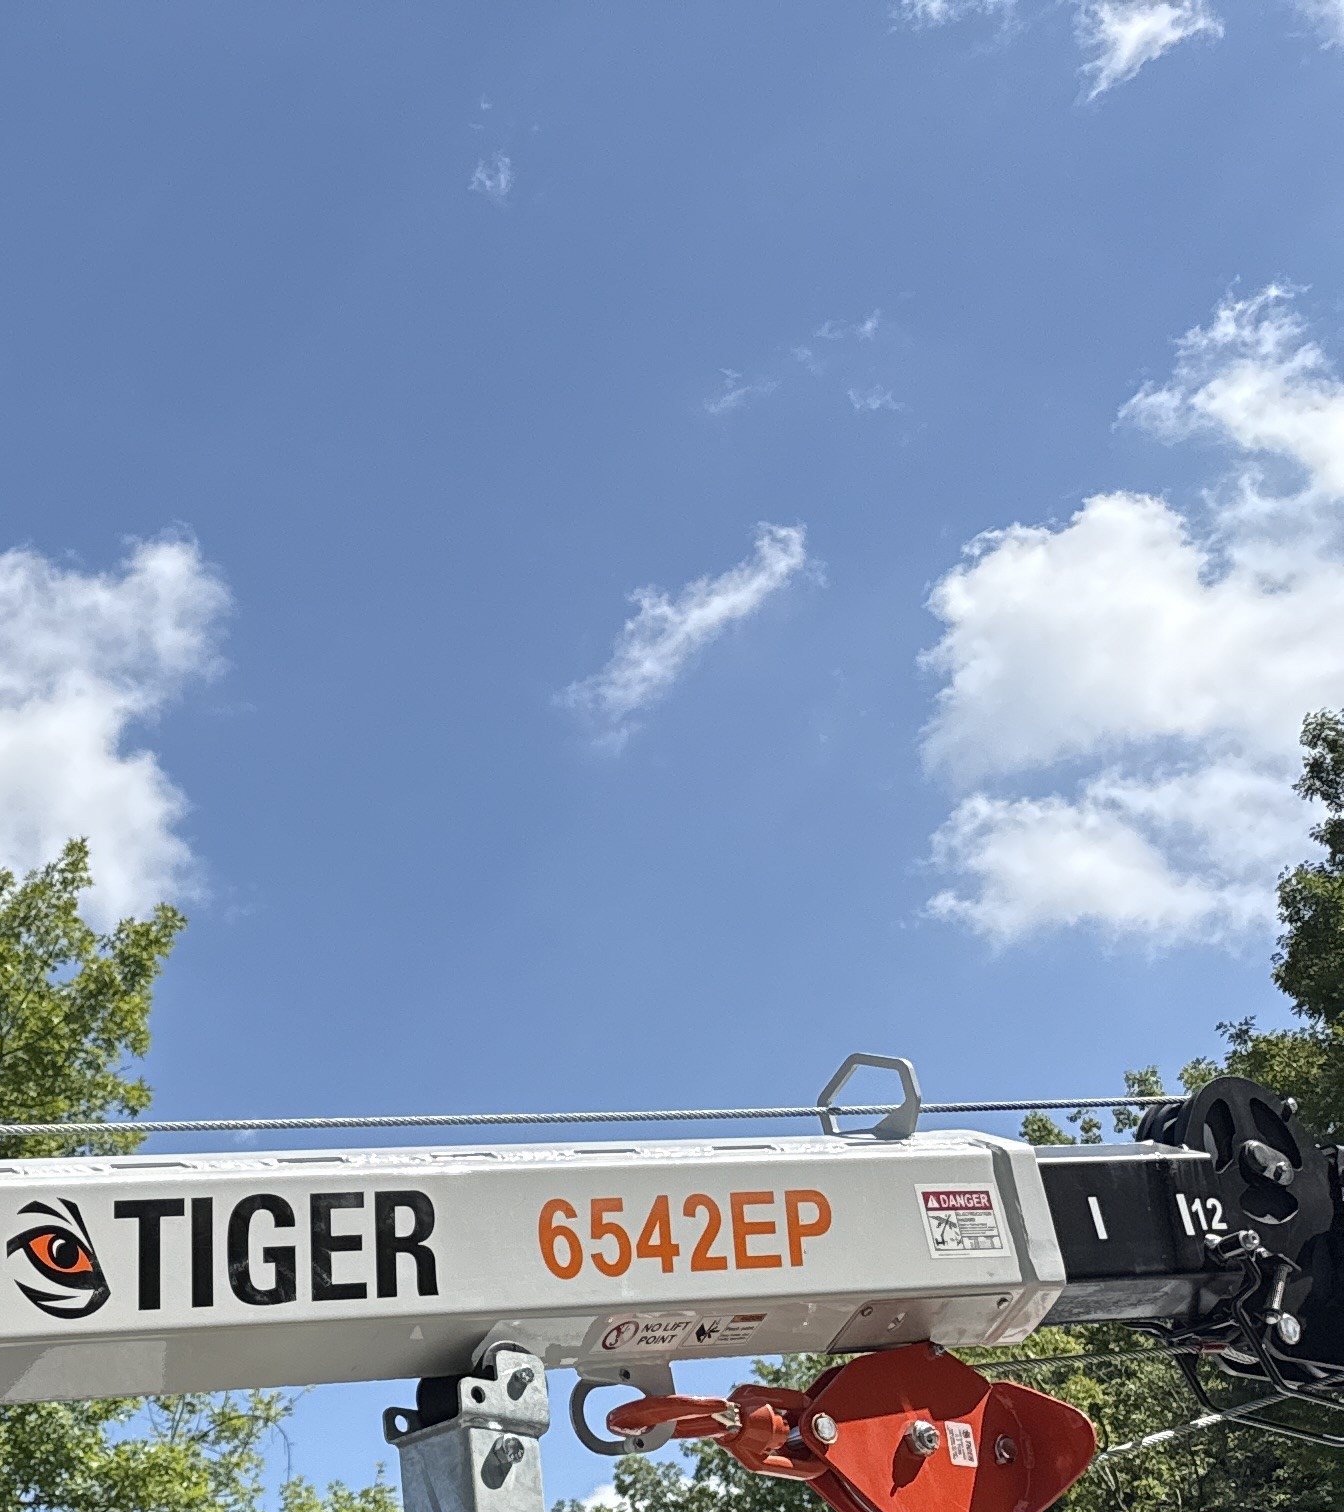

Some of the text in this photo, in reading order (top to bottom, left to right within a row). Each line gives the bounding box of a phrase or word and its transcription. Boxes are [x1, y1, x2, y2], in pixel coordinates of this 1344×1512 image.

[940, 1193, 989, 1207] DANGER
[1191, 1198, 1228, 1231] 12
[538, 1189, 832, 1280] 6542EP
[113, 1190, 439, 1310] TIGER
[641, 1321, 692, 1333] NO LIFT
[637, 1334, 677, 1346] POINT
